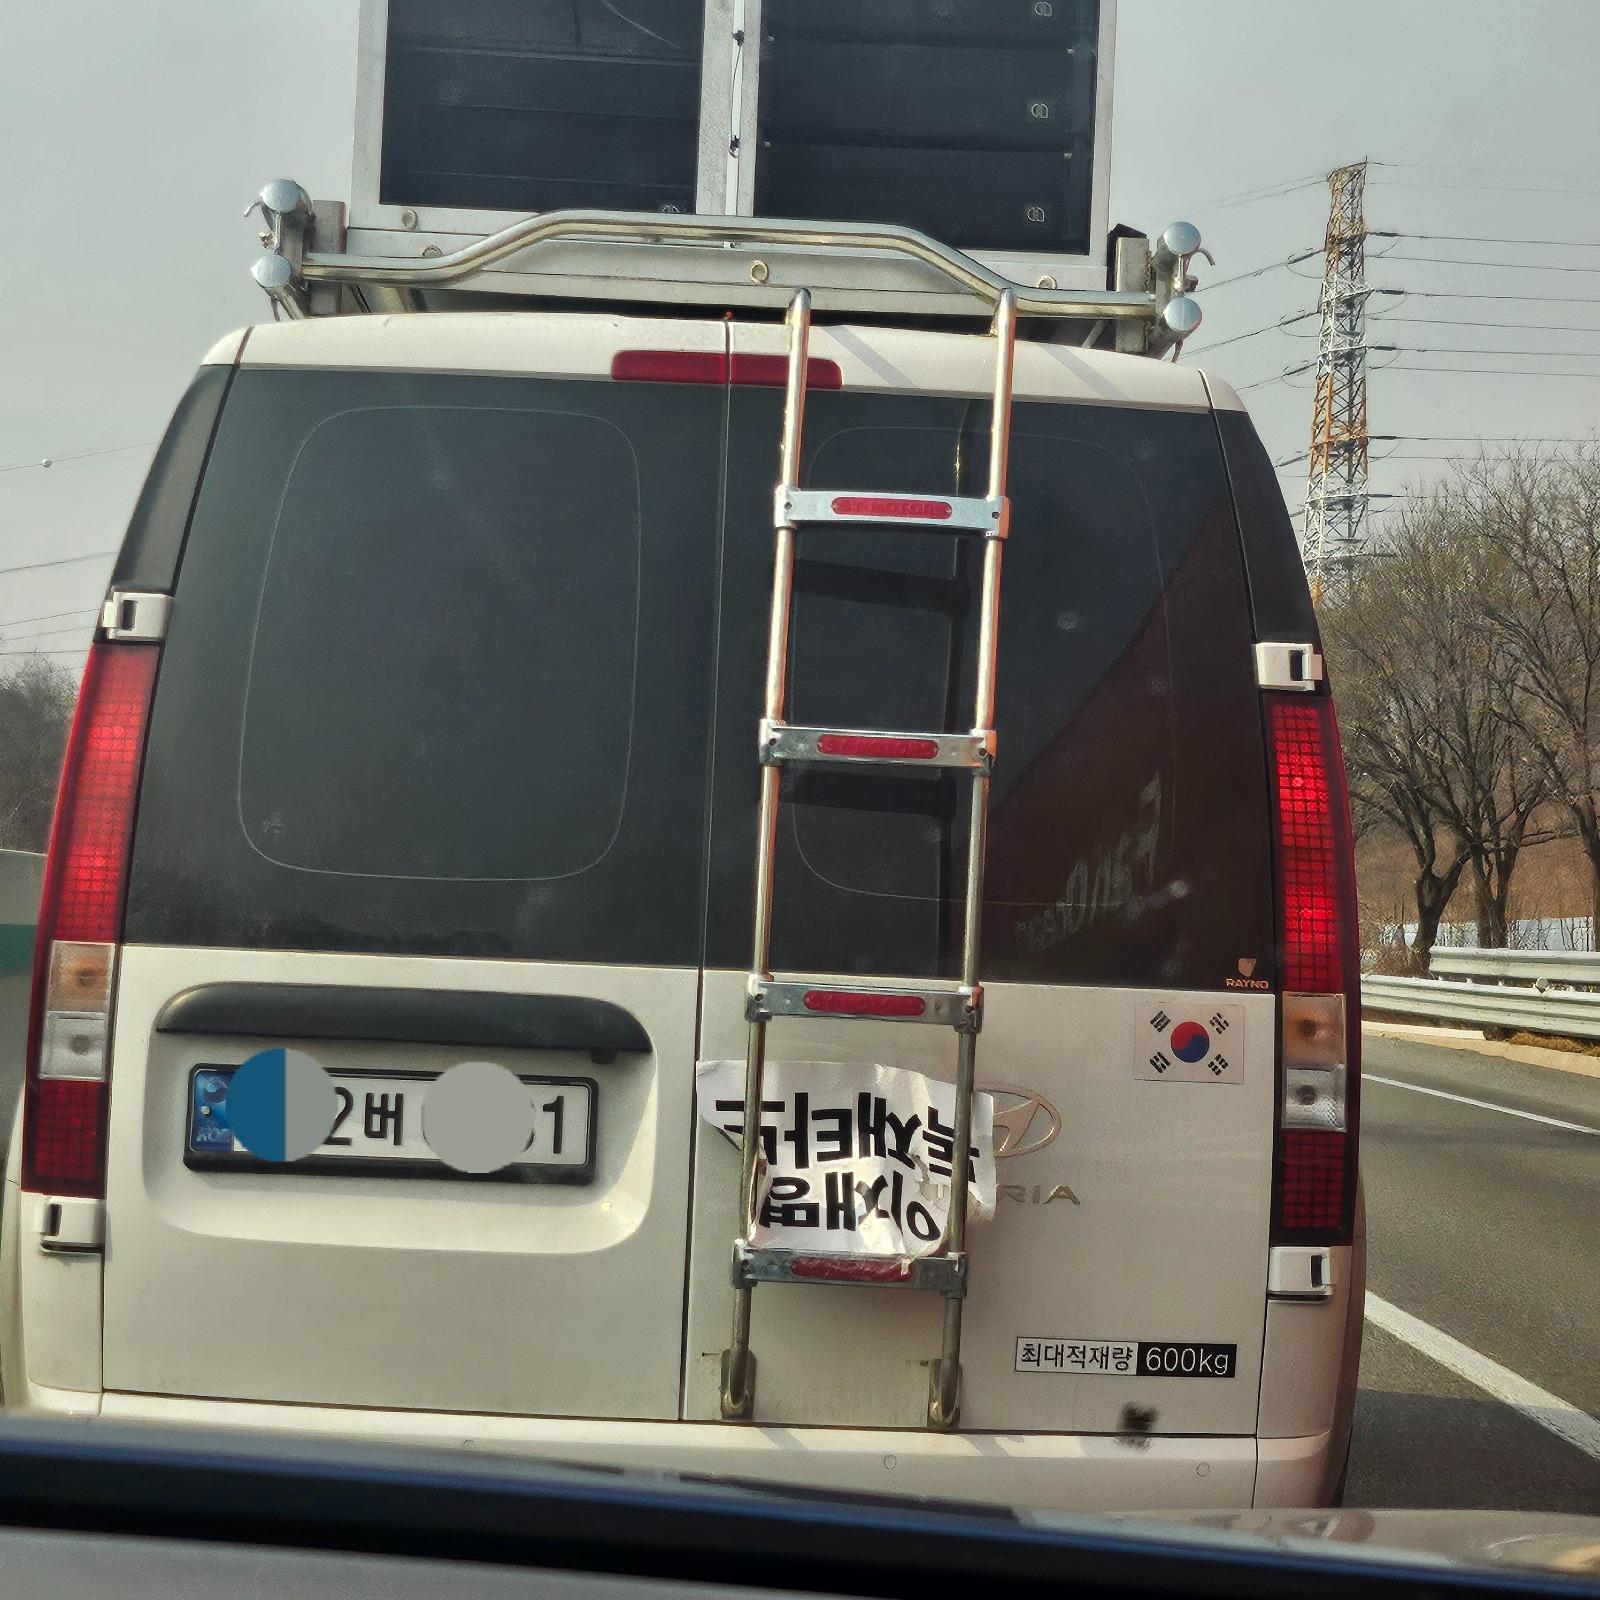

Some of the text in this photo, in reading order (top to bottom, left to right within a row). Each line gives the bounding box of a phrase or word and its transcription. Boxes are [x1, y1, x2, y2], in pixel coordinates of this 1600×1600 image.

[759, 1170, 942, 1241] 이재명
[1021, 1342, 1229, 1376] 최대적재량 600kg
